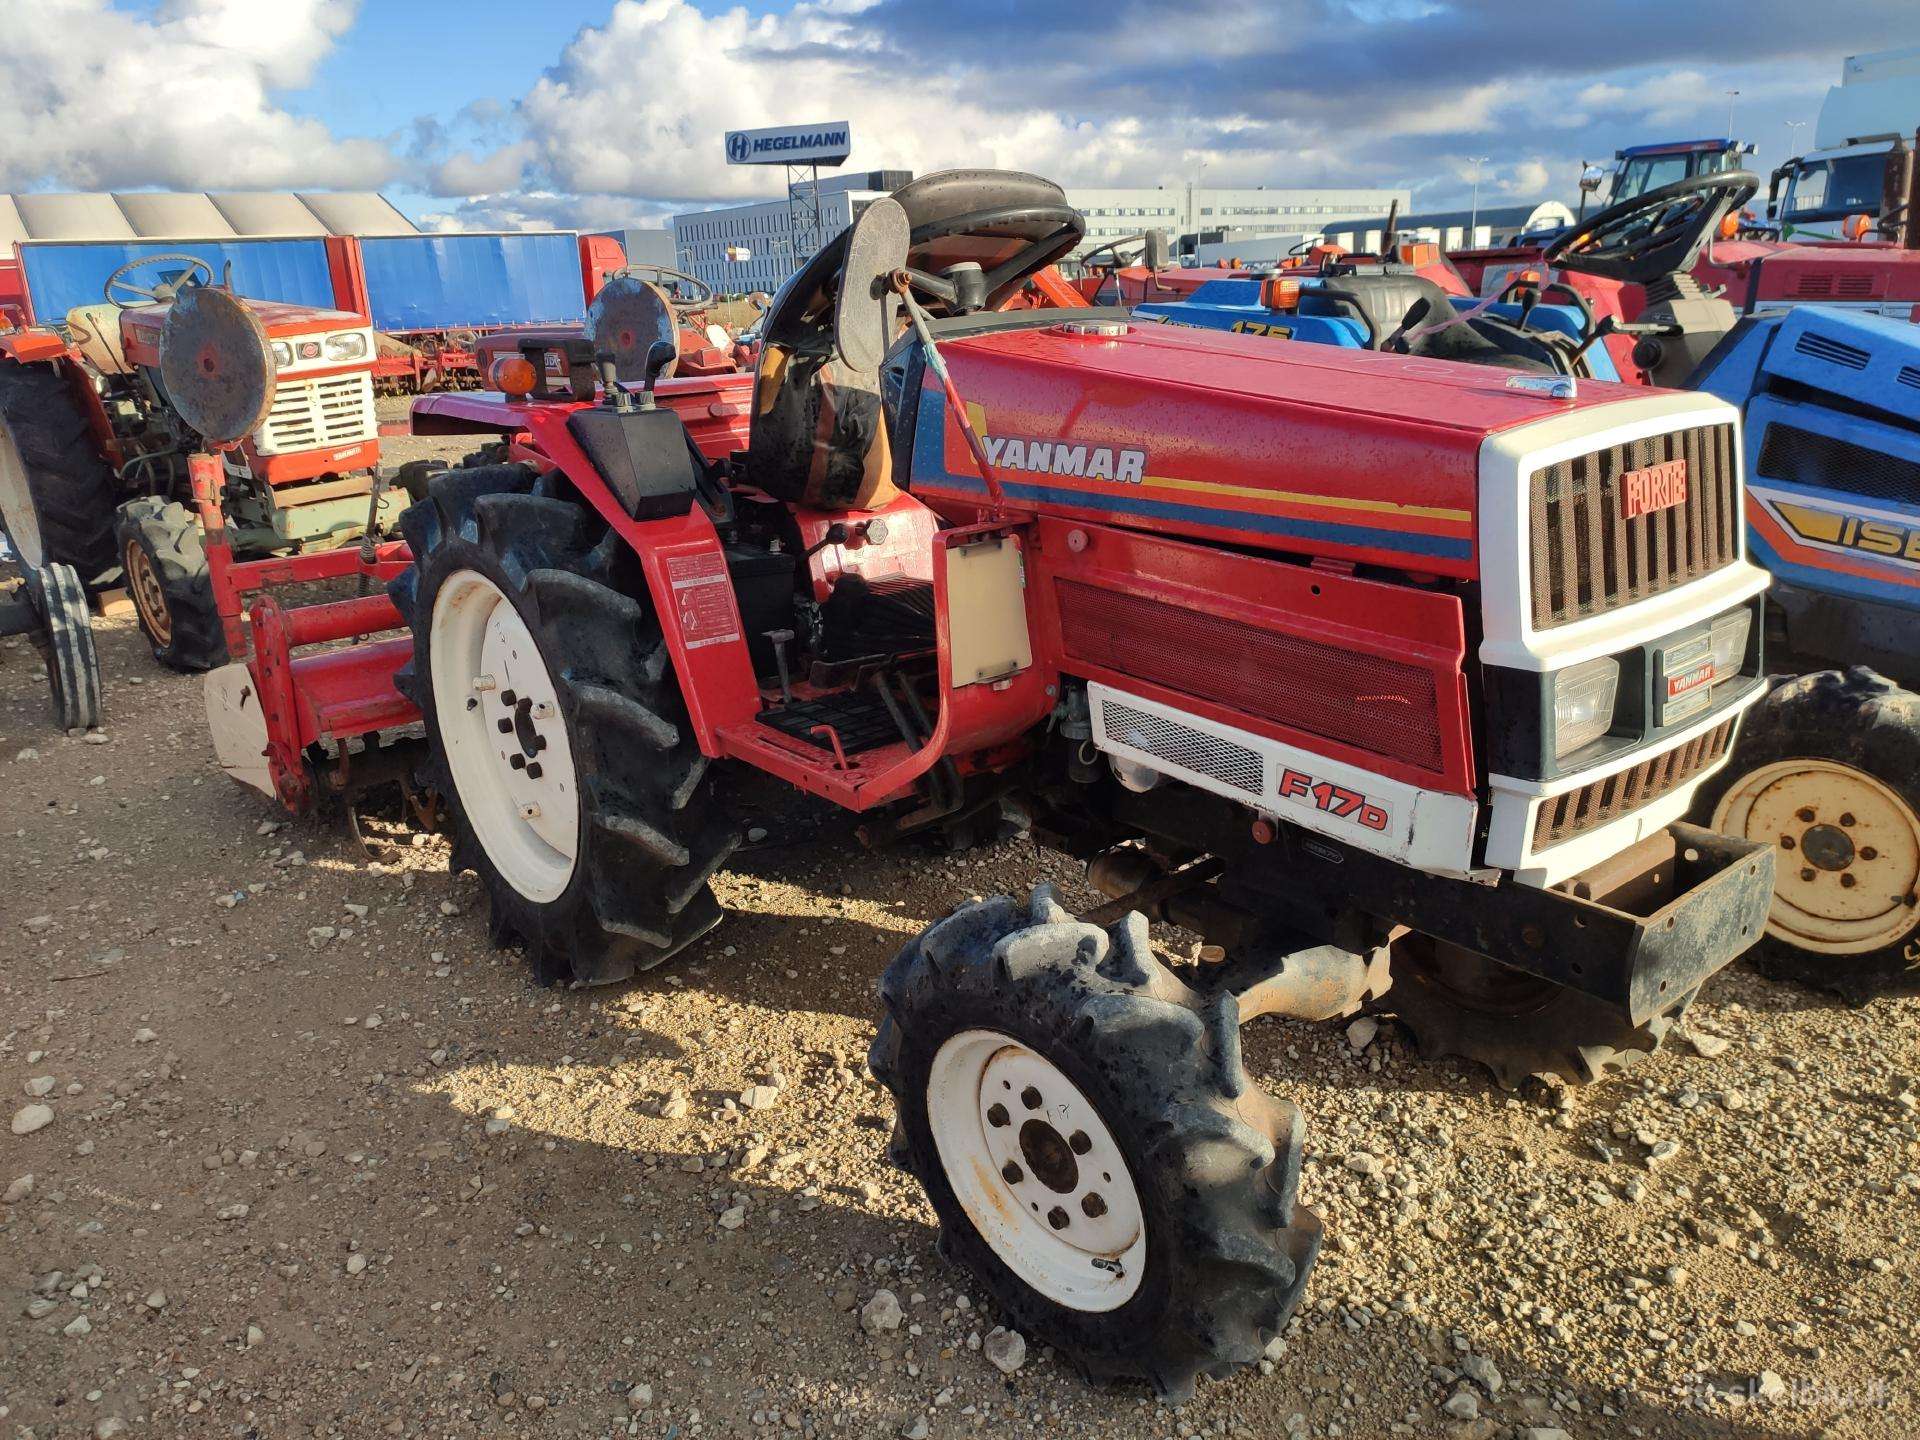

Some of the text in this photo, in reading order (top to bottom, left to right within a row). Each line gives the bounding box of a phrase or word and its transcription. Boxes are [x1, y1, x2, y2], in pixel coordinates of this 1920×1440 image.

[753, 131, 846, 152] HEGELMANN
[981, 435, 1145, 484] YANMAR
[1625, 459, 1687, 520] FORTE
[1672, 665, 1713, 694] YANMAR
[1278, 768, 1389, 831] F17D
